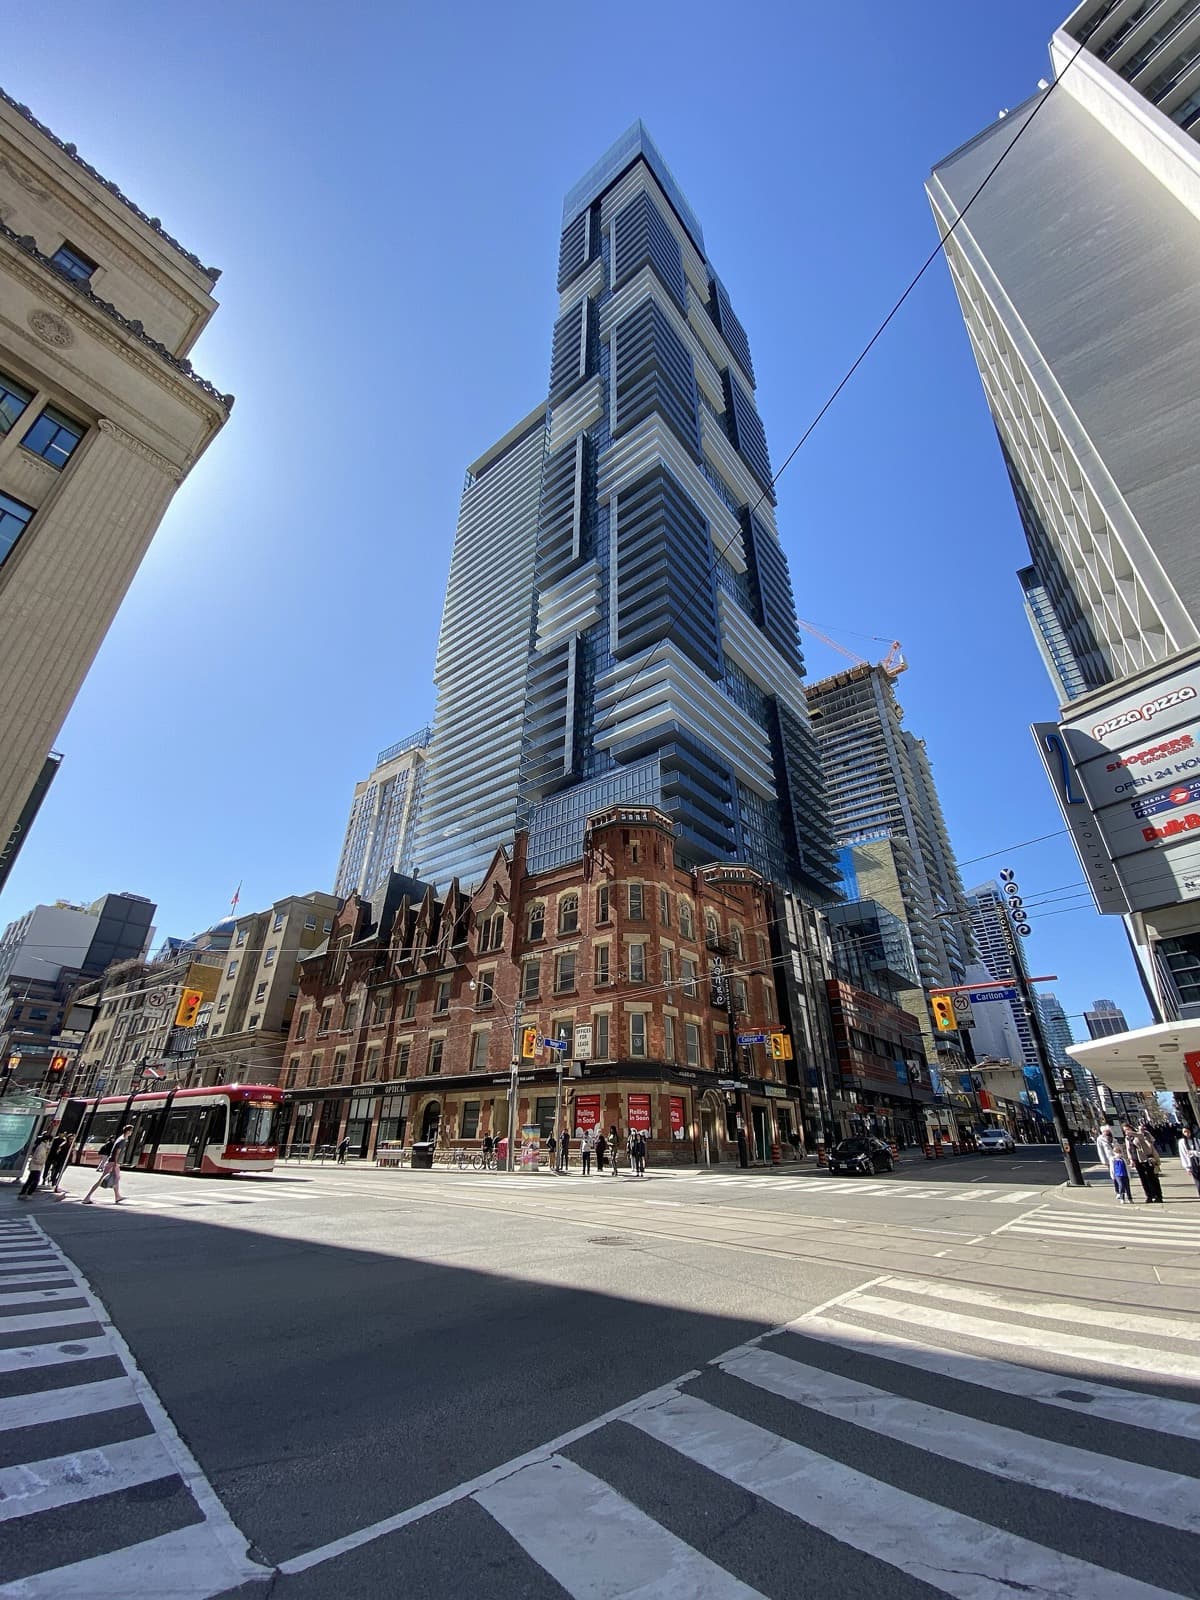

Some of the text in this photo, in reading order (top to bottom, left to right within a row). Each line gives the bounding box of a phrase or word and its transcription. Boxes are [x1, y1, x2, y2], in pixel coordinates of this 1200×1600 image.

[1092, 687, 1197, 741] pizza pizza
[1106, 735, 1193, 772] SHOPPERS
[1114, 775, 1153, 793] OPEN
[1154, 768, 1172, 780] 24
[1135, 795, 1166, 808] CANADA
[1079, 821, 1113, 892] CARLTON
[976, 991, 1004, 1001] Carlton
